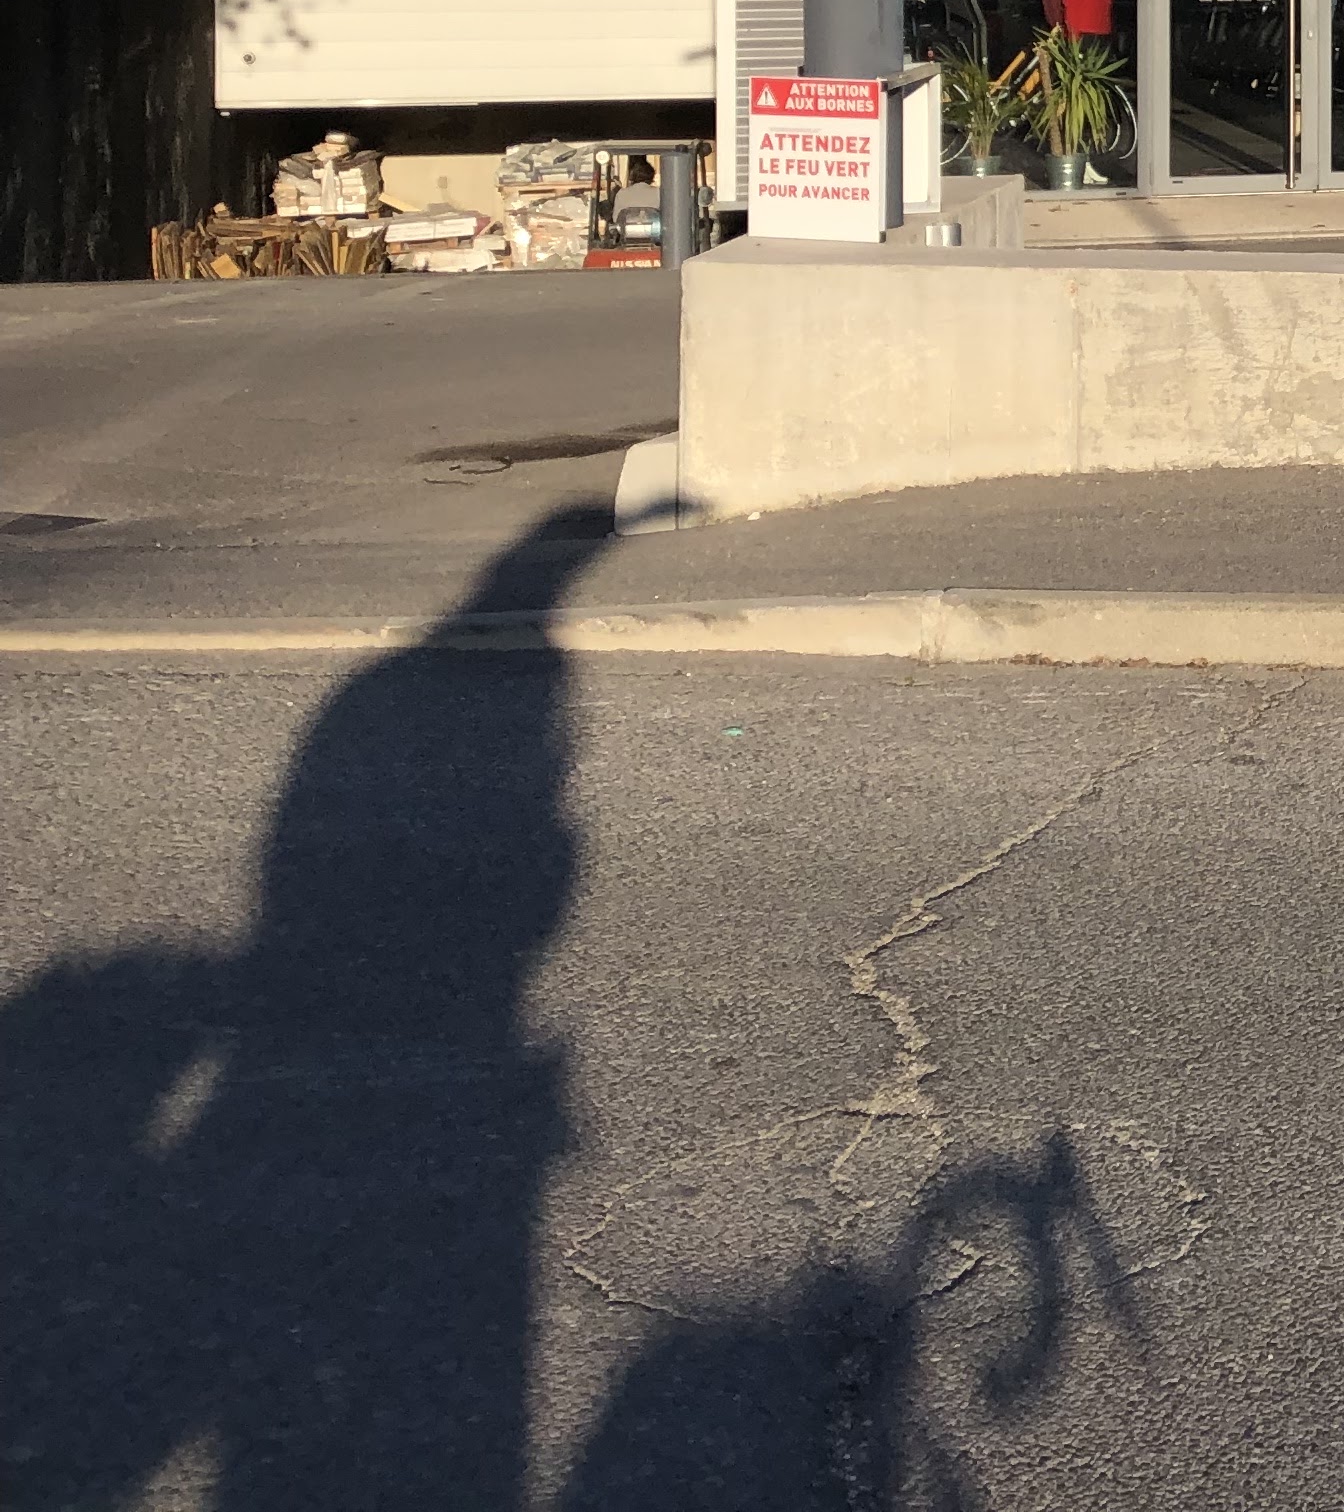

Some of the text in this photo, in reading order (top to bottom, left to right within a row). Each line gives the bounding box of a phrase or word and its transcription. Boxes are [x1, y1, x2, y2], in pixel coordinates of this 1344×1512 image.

[790, 83, 869, 98] ATTENTION
[785, 97, 875, 113] AUX BORNES
[760, 133, 871, 154] ATTENDEZ
[759, 158, 870, 177] LE FEU VERT
[759, 184, 870, 201] POUR AVANCER
[611, 259, 661, 268] NISSAN
